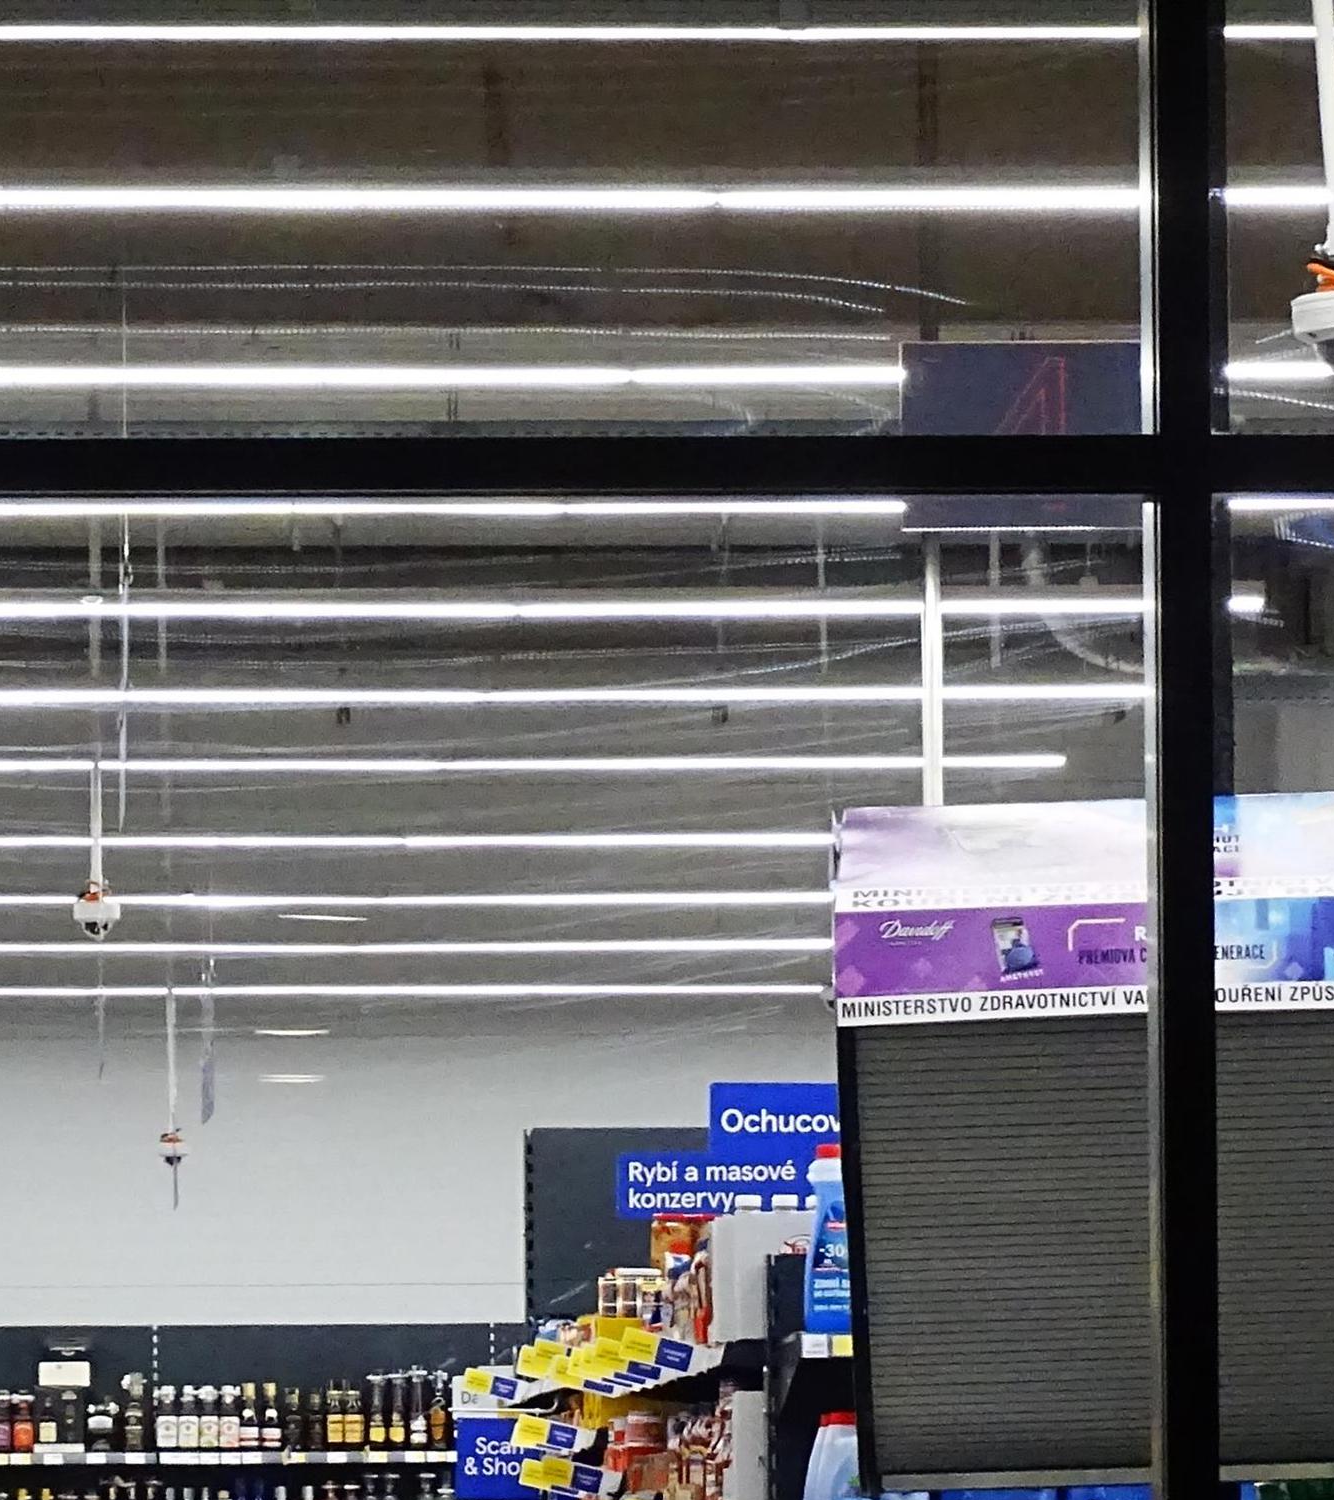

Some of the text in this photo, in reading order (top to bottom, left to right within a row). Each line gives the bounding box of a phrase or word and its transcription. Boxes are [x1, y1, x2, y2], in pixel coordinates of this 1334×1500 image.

[841, 996, 972, 1019] MINISTERSTVO
[979, 988, 1117, 1012] ZDRAVOTNICTVÍ
[627, 1159, 797, 1187] Rybí a masové
[627, 1189, 734, 1213] konzervy
[464, 1456, 479, 1476] &
